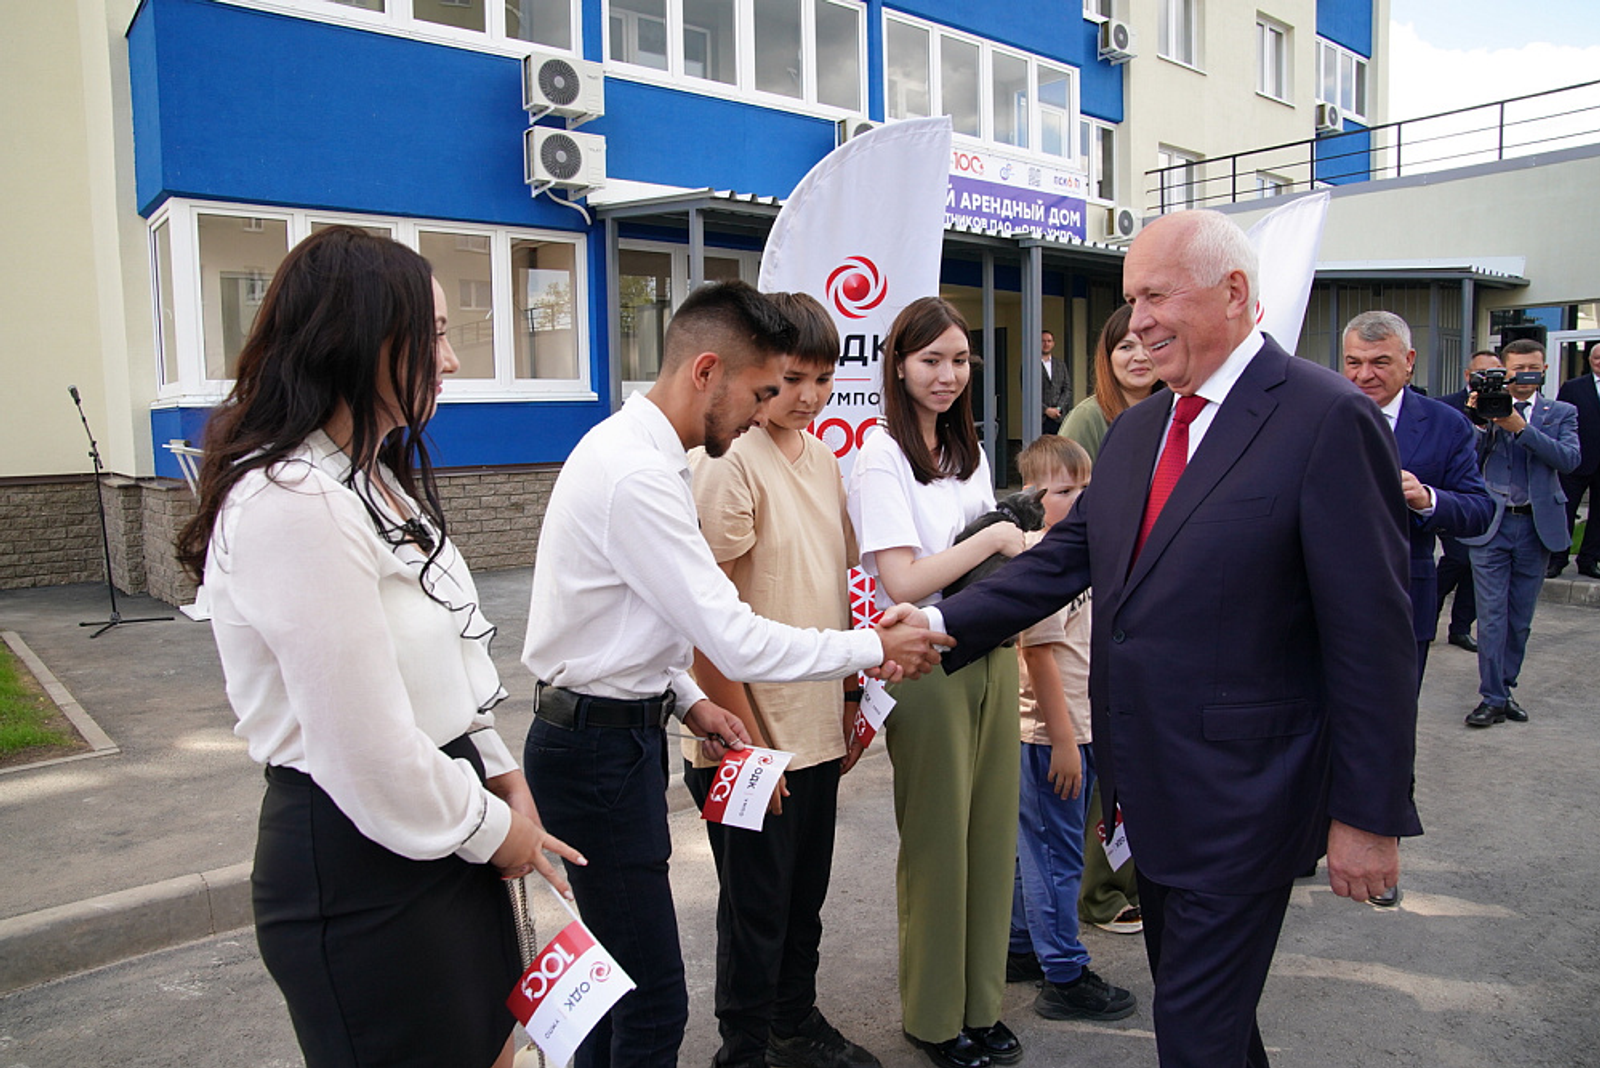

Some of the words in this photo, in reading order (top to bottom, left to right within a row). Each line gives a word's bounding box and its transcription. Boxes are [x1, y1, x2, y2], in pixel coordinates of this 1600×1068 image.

[960, 192, 1045, 222] АРЕНДНЫЙ
[1049, 207, 1081, 227] ДОМ
[838, 334, 886, 366] ДК
[710, 759, 743, 802] 100
[747, 767, 763, 790] ОДК
[521, 943, 575, 1002] 100
[564, 981, 591, 1012] ОДК
